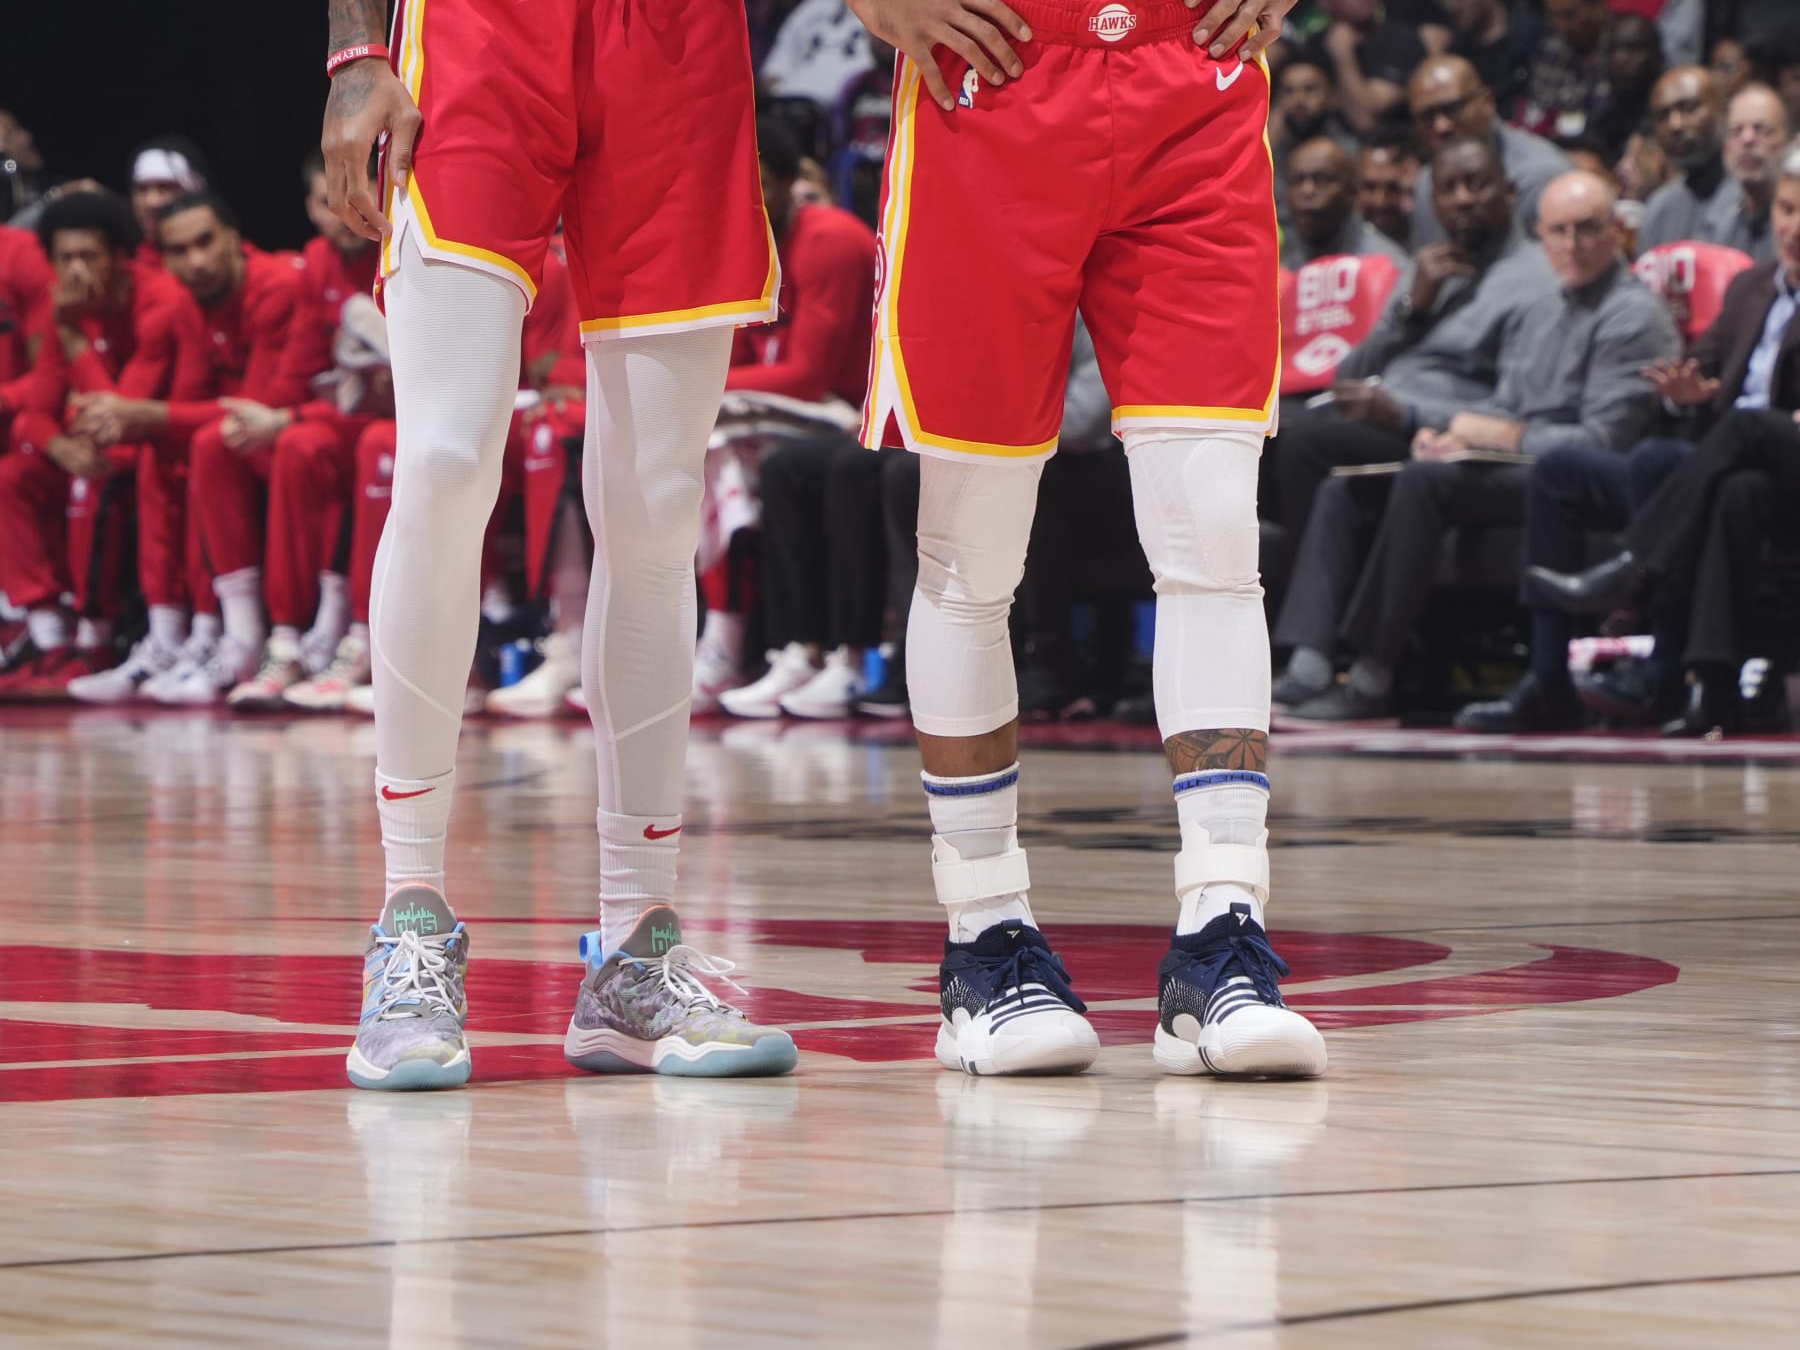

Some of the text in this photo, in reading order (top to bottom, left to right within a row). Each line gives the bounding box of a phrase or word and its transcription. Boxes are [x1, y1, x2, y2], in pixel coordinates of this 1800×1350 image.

[1089, 14, 1137, 31] HAWKS
[343, 46, 369, 60] RILEY
[1297, 255, 1360, 310] BIO
